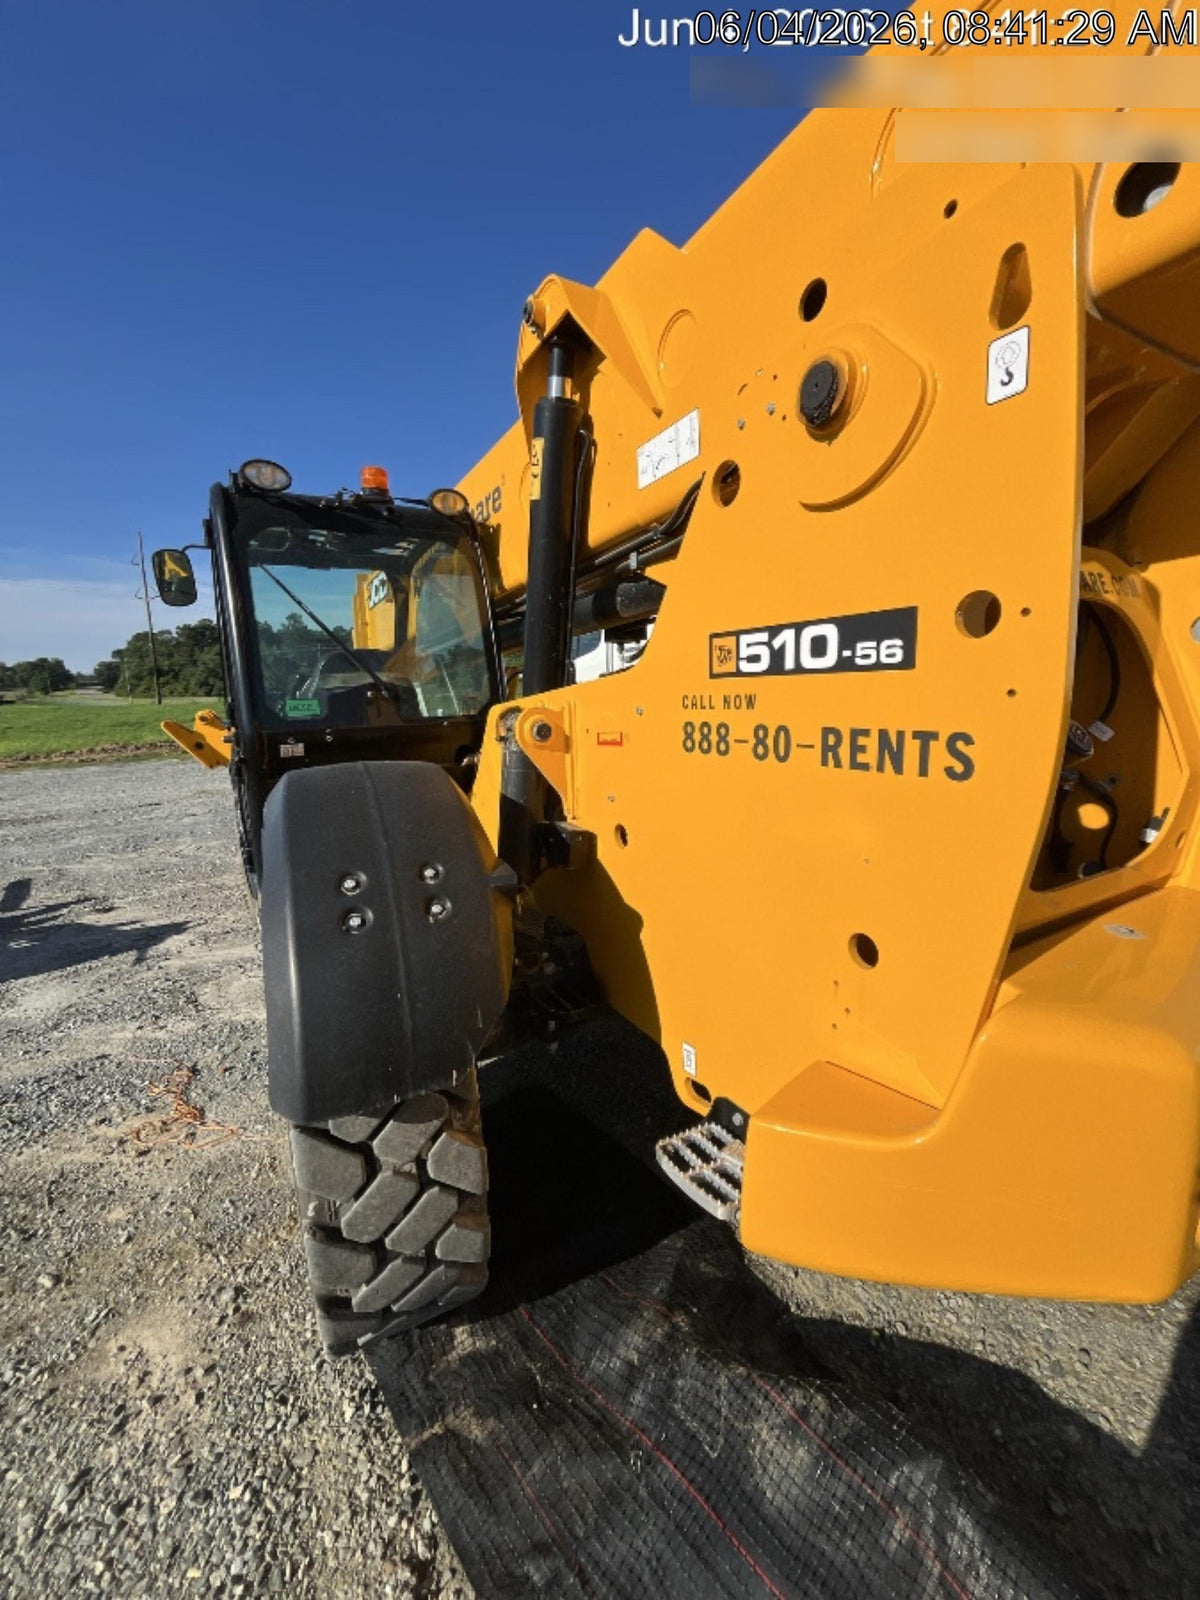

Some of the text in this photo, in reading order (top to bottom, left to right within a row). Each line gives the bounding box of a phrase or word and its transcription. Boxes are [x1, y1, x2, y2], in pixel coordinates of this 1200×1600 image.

[738, 624, 904, 673] 510-56
[682, 693, 757, 710] CALL NOW
[682, 721, 976, 782] 888-80-RENTS
